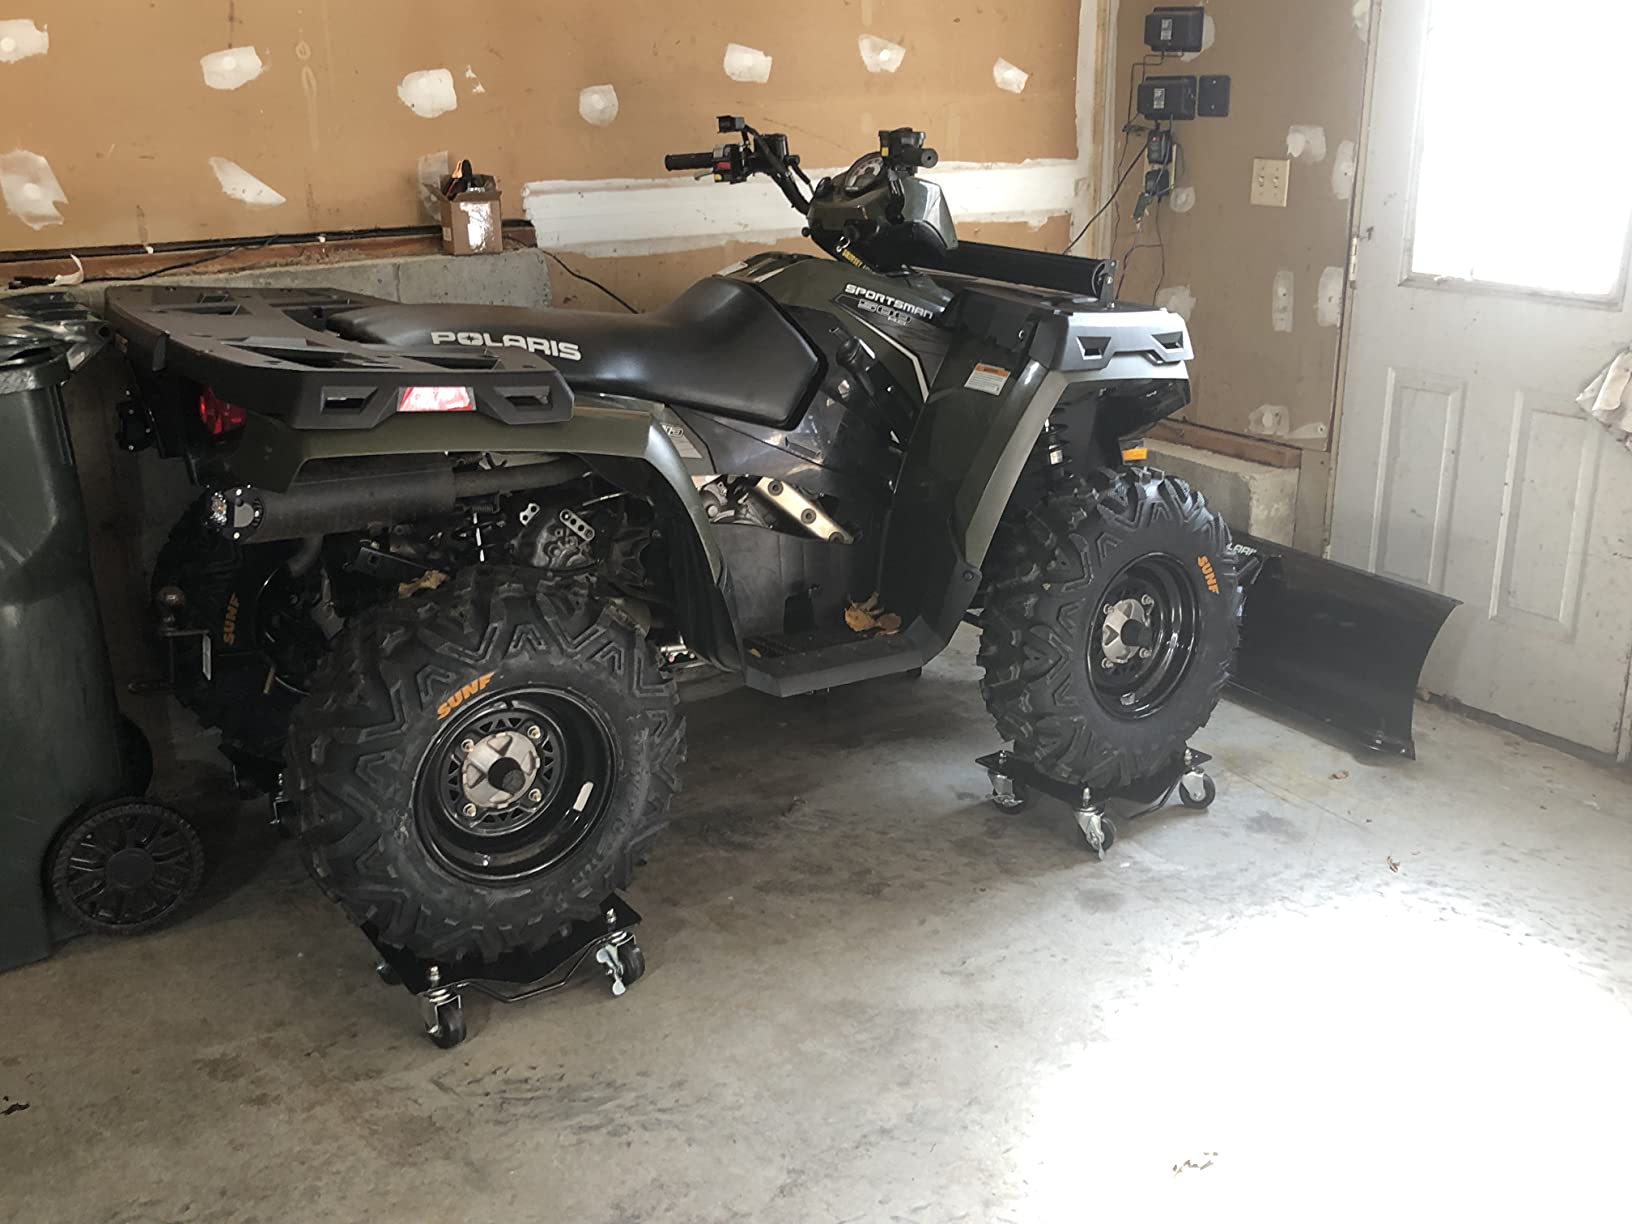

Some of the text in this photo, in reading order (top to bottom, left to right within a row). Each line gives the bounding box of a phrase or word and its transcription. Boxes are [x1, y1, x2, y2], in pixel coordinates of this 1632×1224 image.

[845, 283, 934, 320] SPORTSMAN
[430, 331, 582, 361] POLARIS
[1226, 542, 1257, 556] LARI
[1197, 554, 1220, 594] SUNF
[223, 591, 240, 646] SUNF
[436, 670, 496, 720] SUNF
